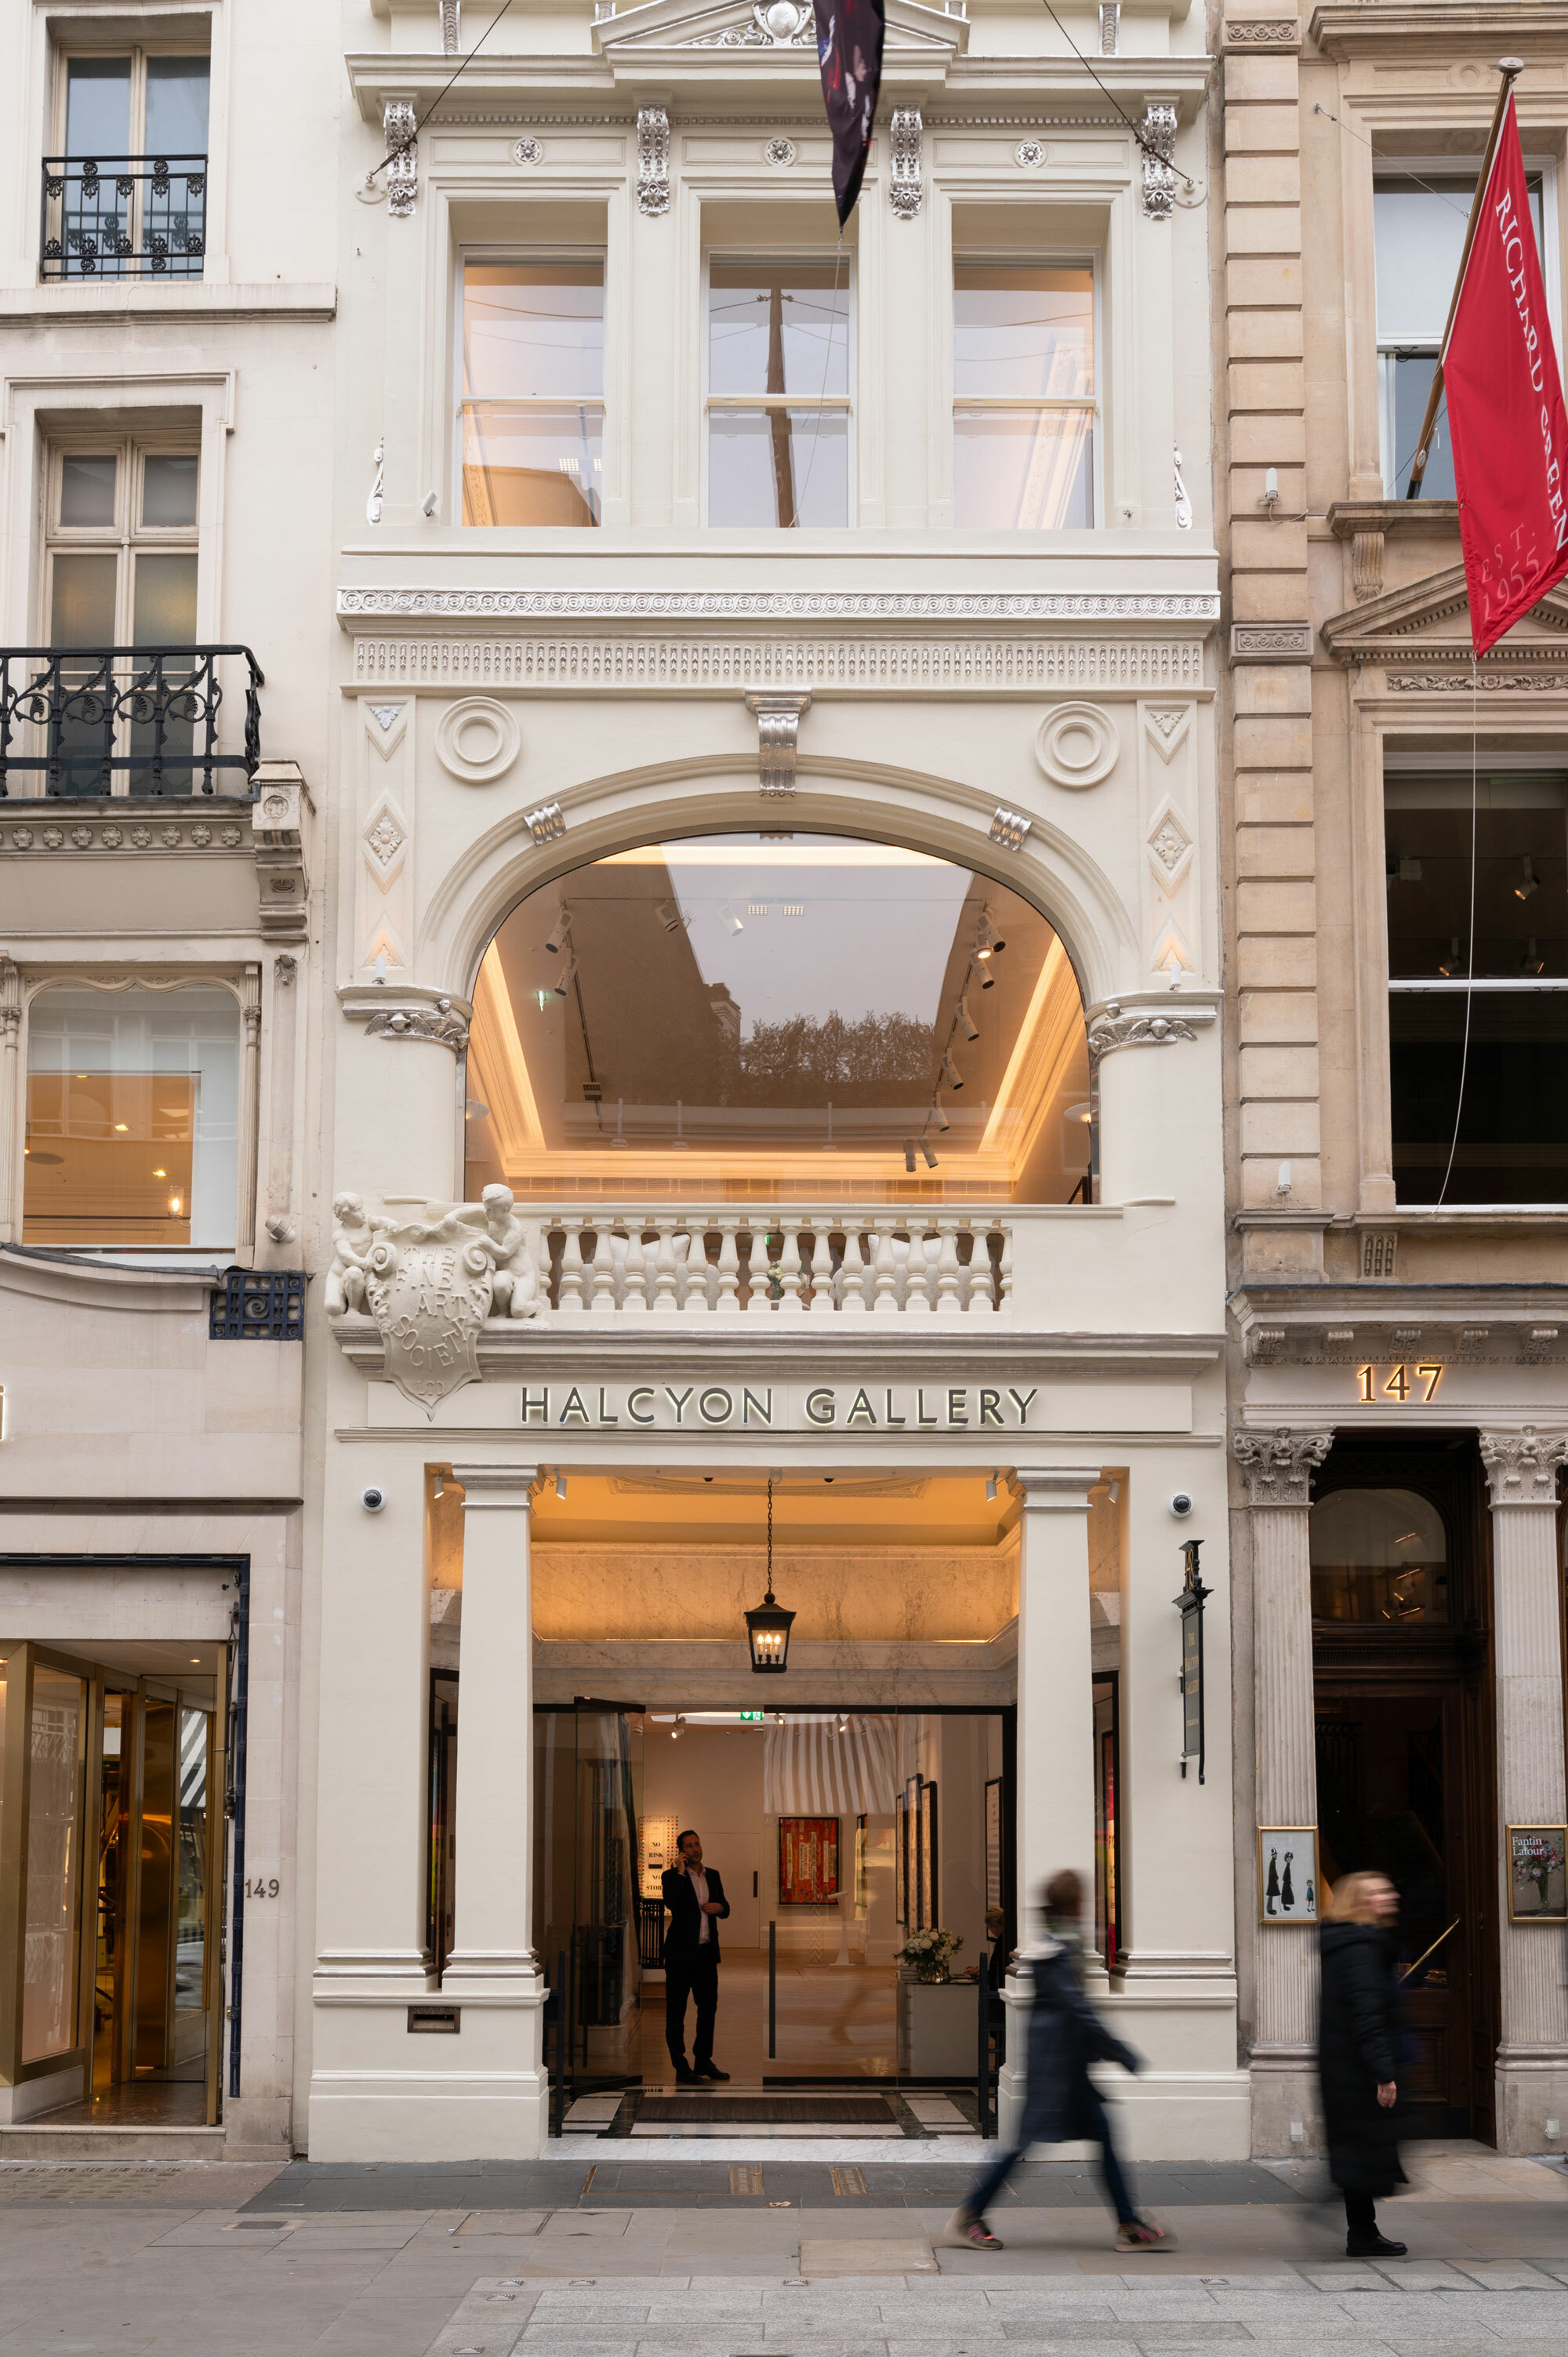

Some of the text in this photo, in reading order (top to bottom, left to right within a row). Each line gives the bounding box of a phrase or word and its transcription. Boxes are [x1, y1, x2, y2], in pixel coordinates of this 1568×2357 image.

[1496, 187, 1568, 551] RICHARD GREEN
[1482, 522, 1536, 584] EST.
[1483, 545, 1539, 624] 1955
[404, 1248, 456, 1266] THE
[395, 1266, 453, 1292] FINE
[416, 1291, 467, 1322] ART
[389, 1314, 468, 1371] SOCIETY
[416, 1380, 445, 1396] LTD
[1358, 1364, 1443, 1402] 147
[521, 1387, 1039, 1425] HALCYON GALLERY
[1512, 1836, 1542, 1846] Fantin
[1512, 1847, 1544, 1856] Latour
[245, 1878, 280, 1898] 149
